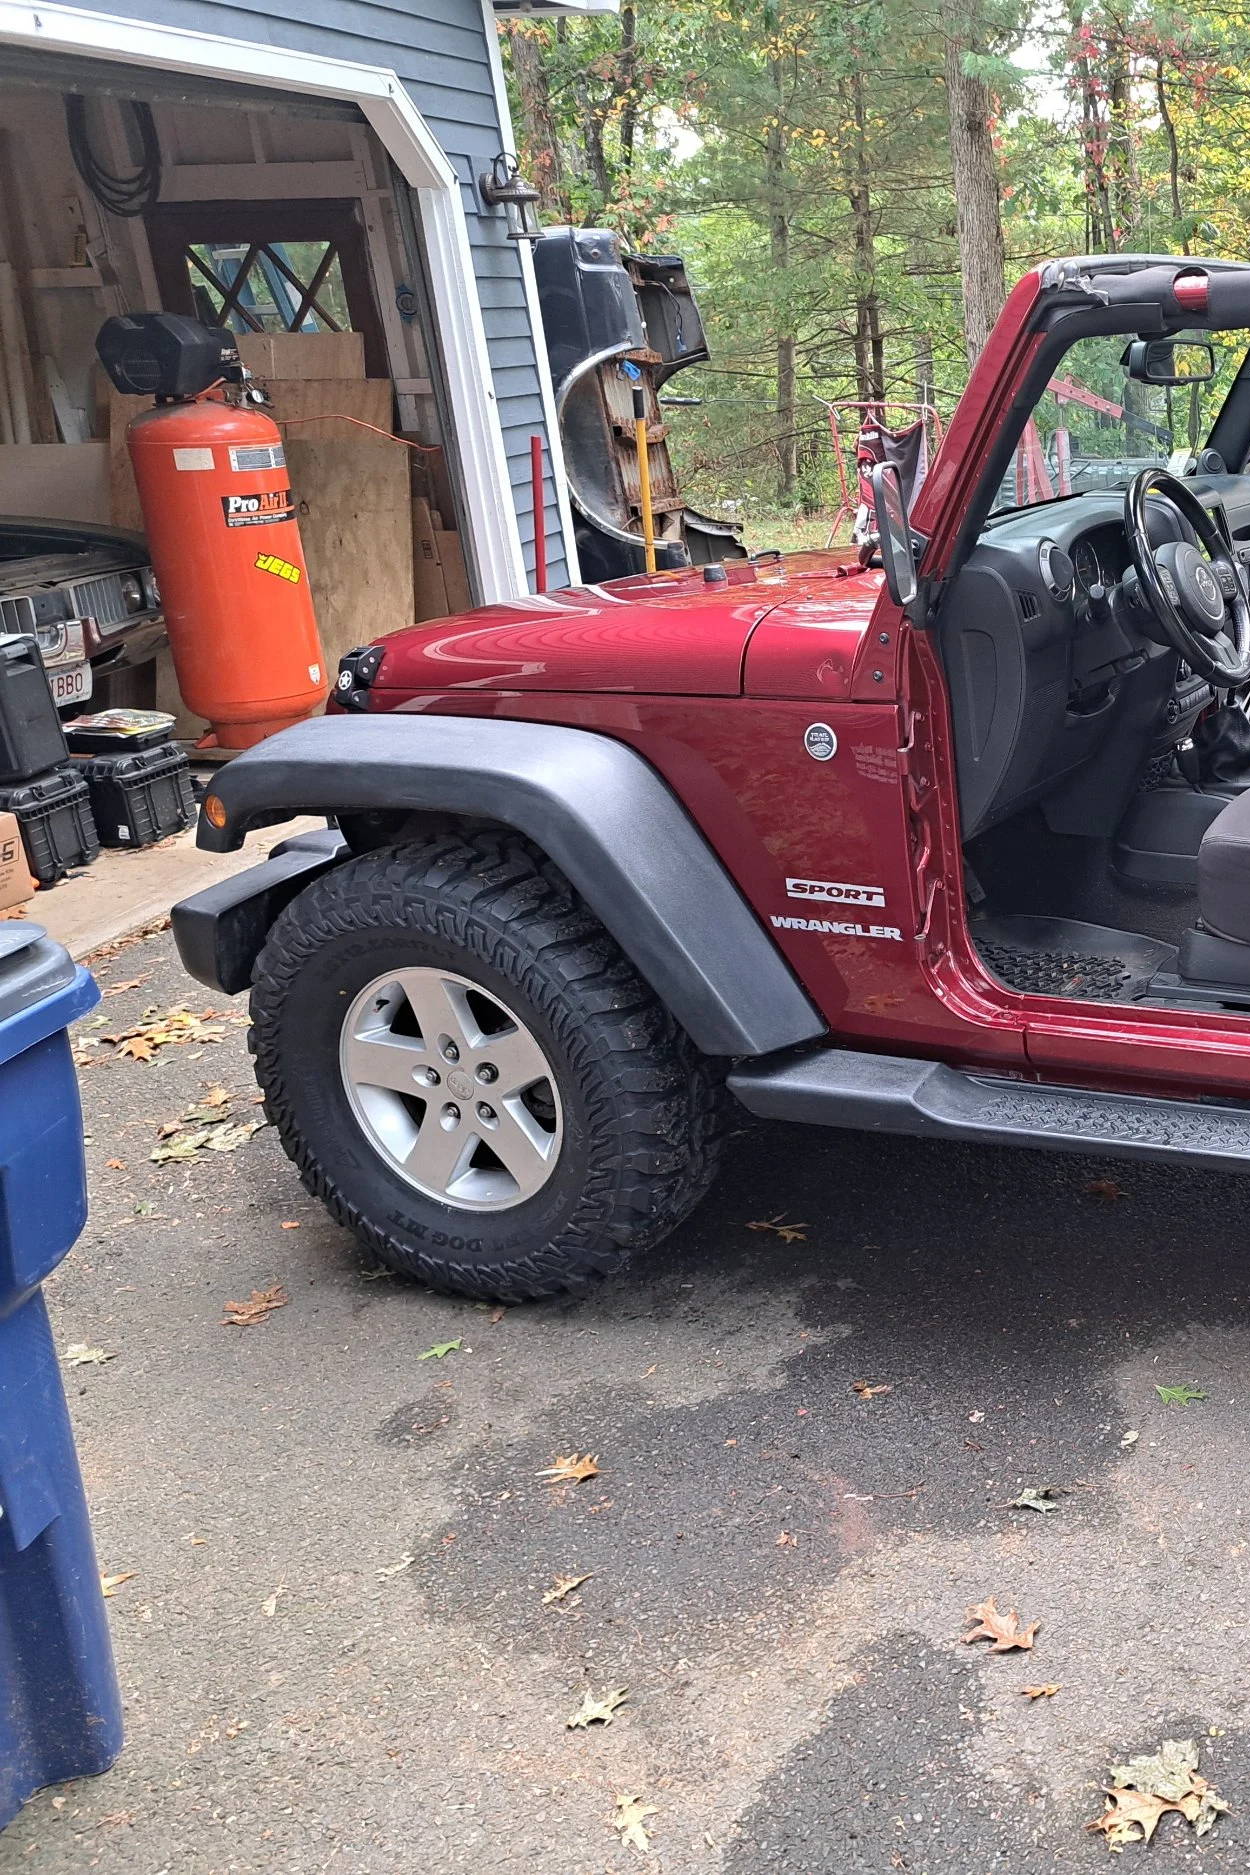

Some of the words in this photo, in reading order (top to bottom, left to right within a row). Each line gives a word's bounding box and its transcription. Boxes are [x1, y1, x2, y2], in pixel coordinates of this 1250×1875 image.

[254, 552, 301, 584] JEGS
[791, 882, 884, 902] SPORT
[769, 915, 904, 942] WRANGLER
[431, 1230, 484, 1253] DOG
